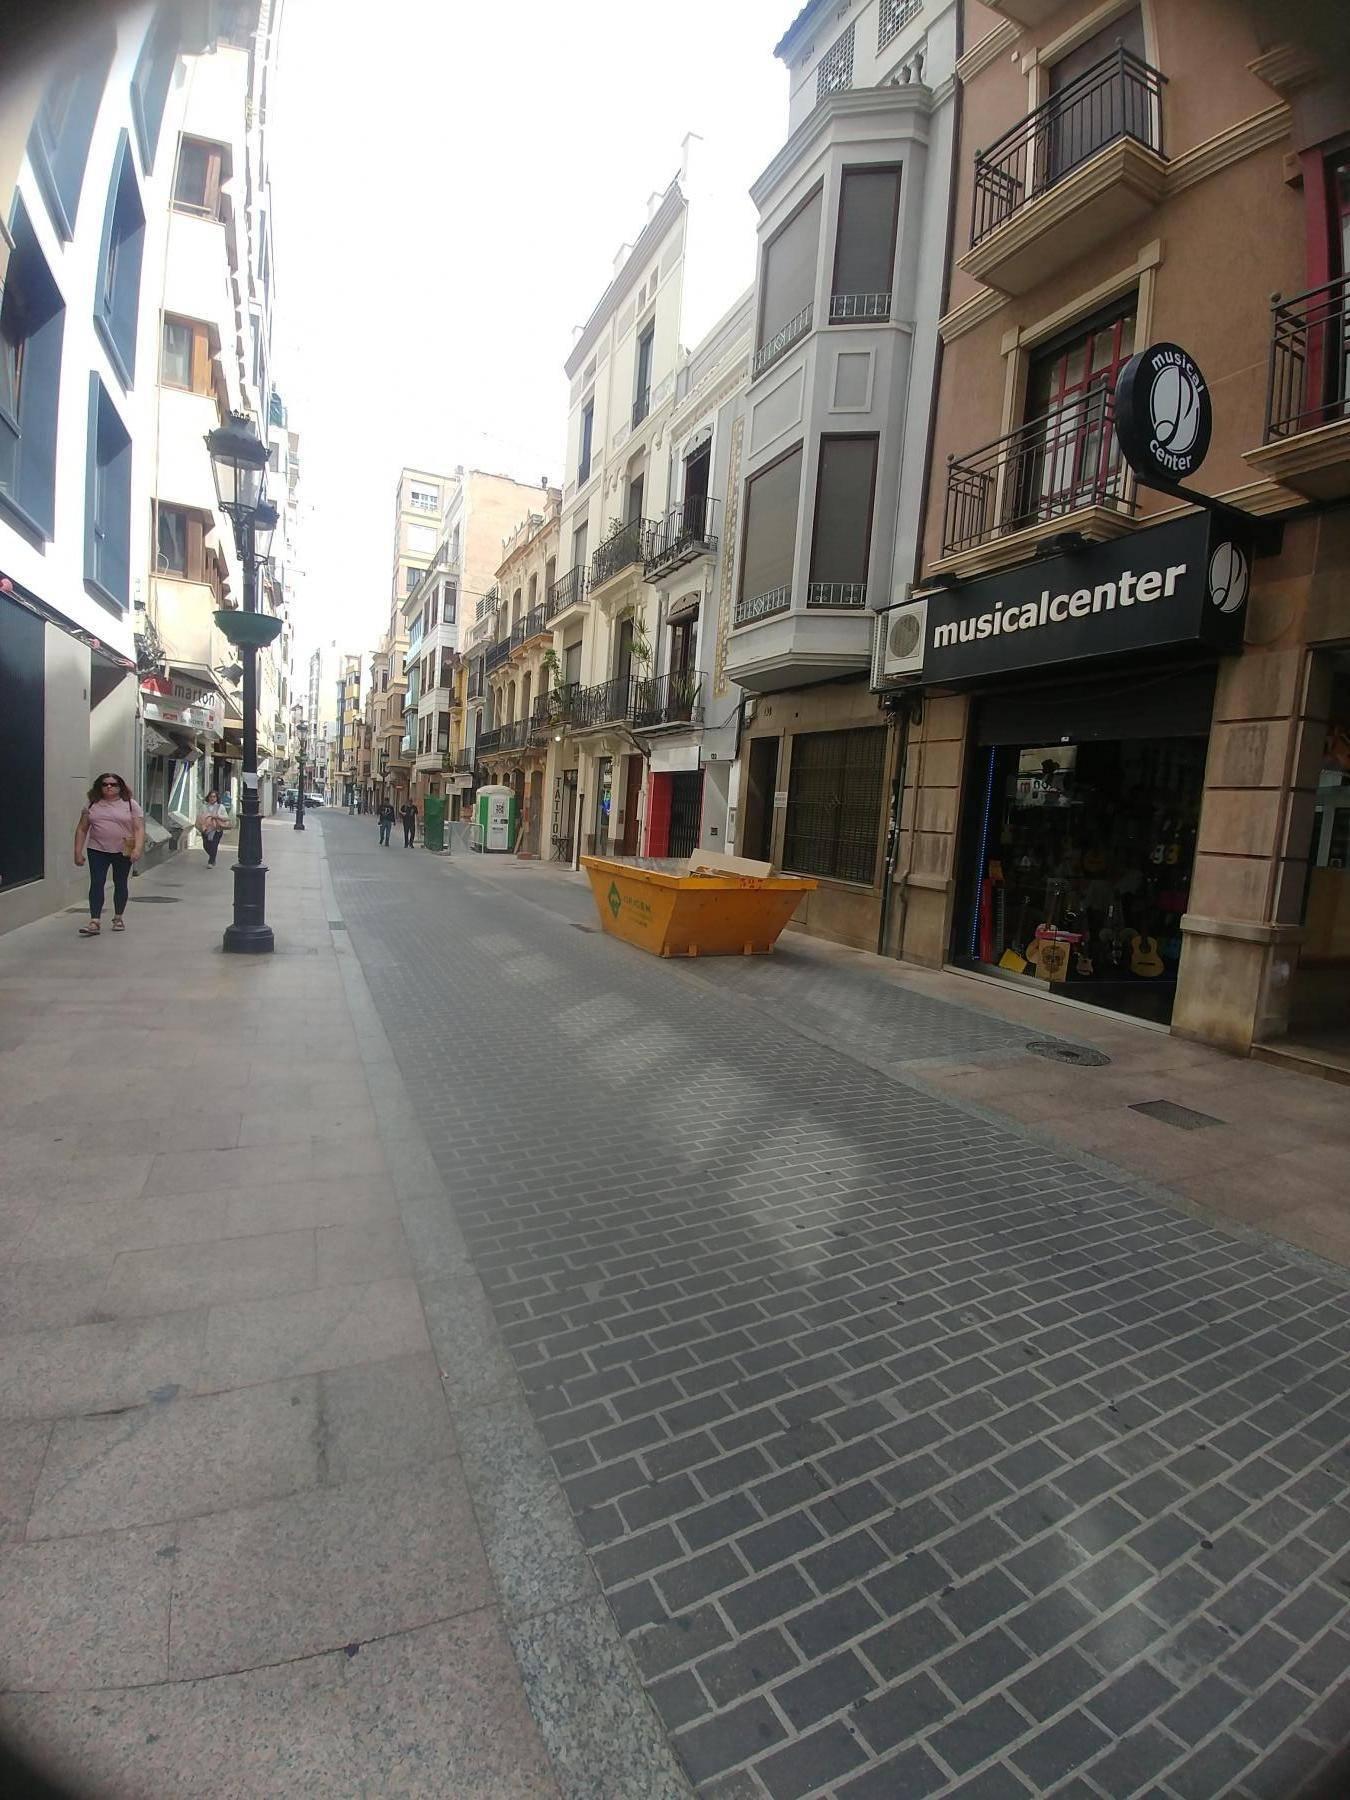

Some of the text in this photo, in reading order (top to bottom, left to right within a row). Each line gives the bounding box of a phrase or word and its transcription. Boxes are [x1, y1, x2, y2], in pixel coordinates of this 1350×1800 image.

[1152, 351, 1205, 393] musical
[1150, 439, 1192, 471] center
[933, 564, 1187, 648] musicalcenter
